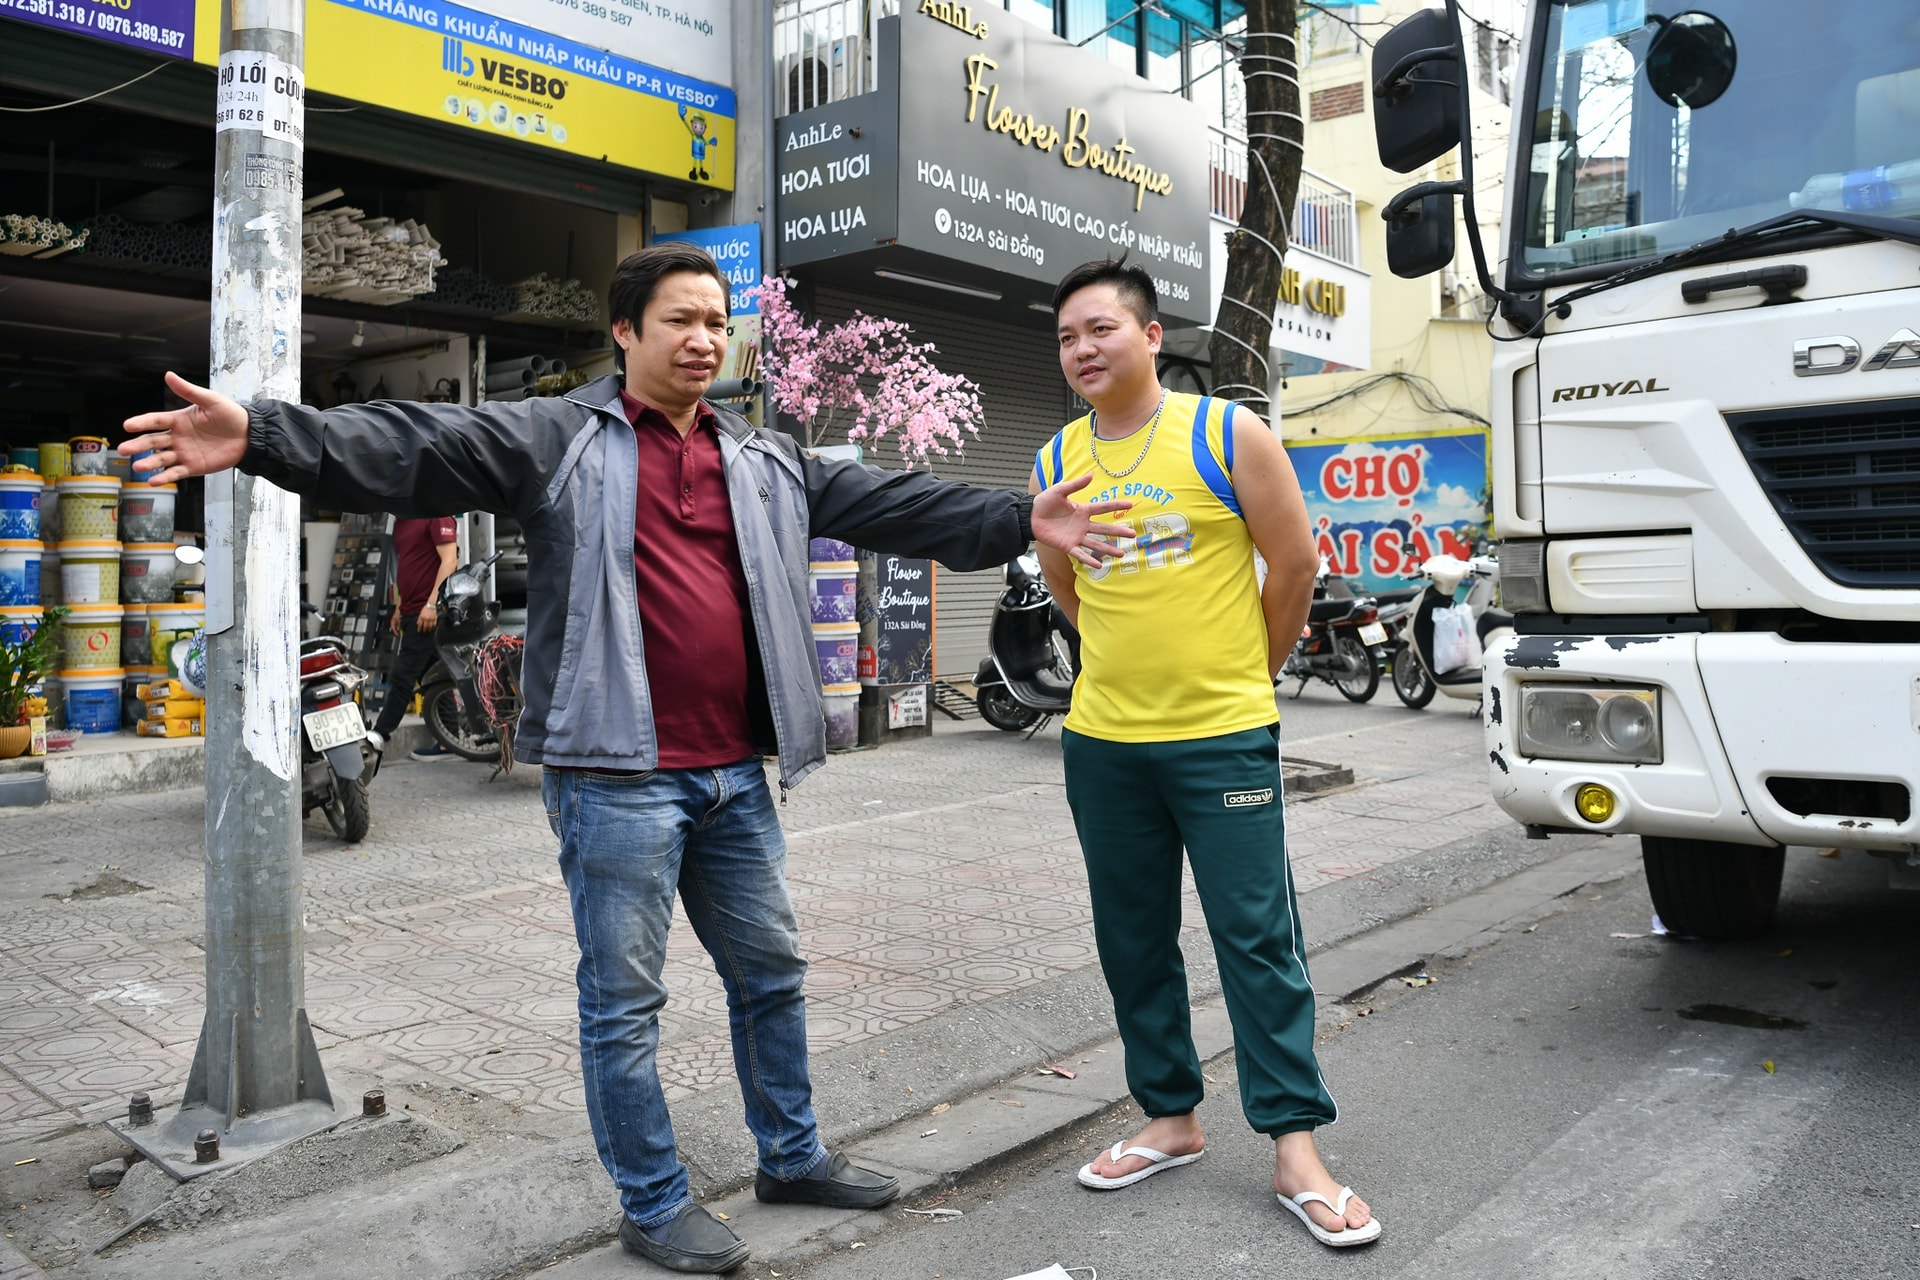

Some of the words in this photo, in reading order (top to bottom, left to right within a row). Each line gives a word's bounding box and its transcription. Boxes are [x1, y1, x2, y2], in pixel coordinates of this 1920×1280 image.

[98, 12, 185, 48] 0976.389.587
[582, 1, 607, 19] 389
[610, 10, 632, 27] 587
[655, 5, 672, 21] TP.
[675, 12, 691, 28] HÀ
[694, 19, 714, 36] NỘI
[919, 0, 989, 40] AnhLe
[444, 20, 513, 49] KHUẨN
[518, 37, 569, 66] NHẬP
[574, 56, 621, 81] KHẨU
[626, 72, 662, 93] PP-R
[274, 76, 300, 101] CỨU
[480, 57, 566, 100] VESBO
[784, 121, 843, 152] AnhLe
[965, 52, 1061, 154] Flower
[1062, 106, 1174, 212] Boutique
[781, 166, 823, 196] HOA
[827, 153, 870, 184] TƯƠI
[784, 213, 827, 243] HOA
[831, 205, 867, 236] LỤA
[917, 159, 956, 193] HOA
[961, 173, 991, 204] LỤA
[1005, 188, 1038, 219] HOA
[1040, 199, 1071, 229] TƯƠI
[1074, 212, 1105, 240] CAO
[1108, 221, 1136, 249] CẤP
[1138, 234, 1171, 262] NHẬP
[1173, 241, 1203, 270] KHẨU
[953, 219, 985, 244] 132A
[988, 229, 1008, 252] Sài
[1010, 233, 1045, 266] Đồng
[1172, 282, 1190, 302] 366
[1304, 278, 1345, 318] CHU
[1552, 377, 1670, 403] ROYAL
[1323, 447, 1422, 507] CHỢ
[1124, 482, 1175, 507] SPORT
[886, 556, 923, 583] Flower
[880, 586, 931, 616] Boutique
[884, 621, 900, 631] 132A
[1228, 794, 1262, 804] adidas
